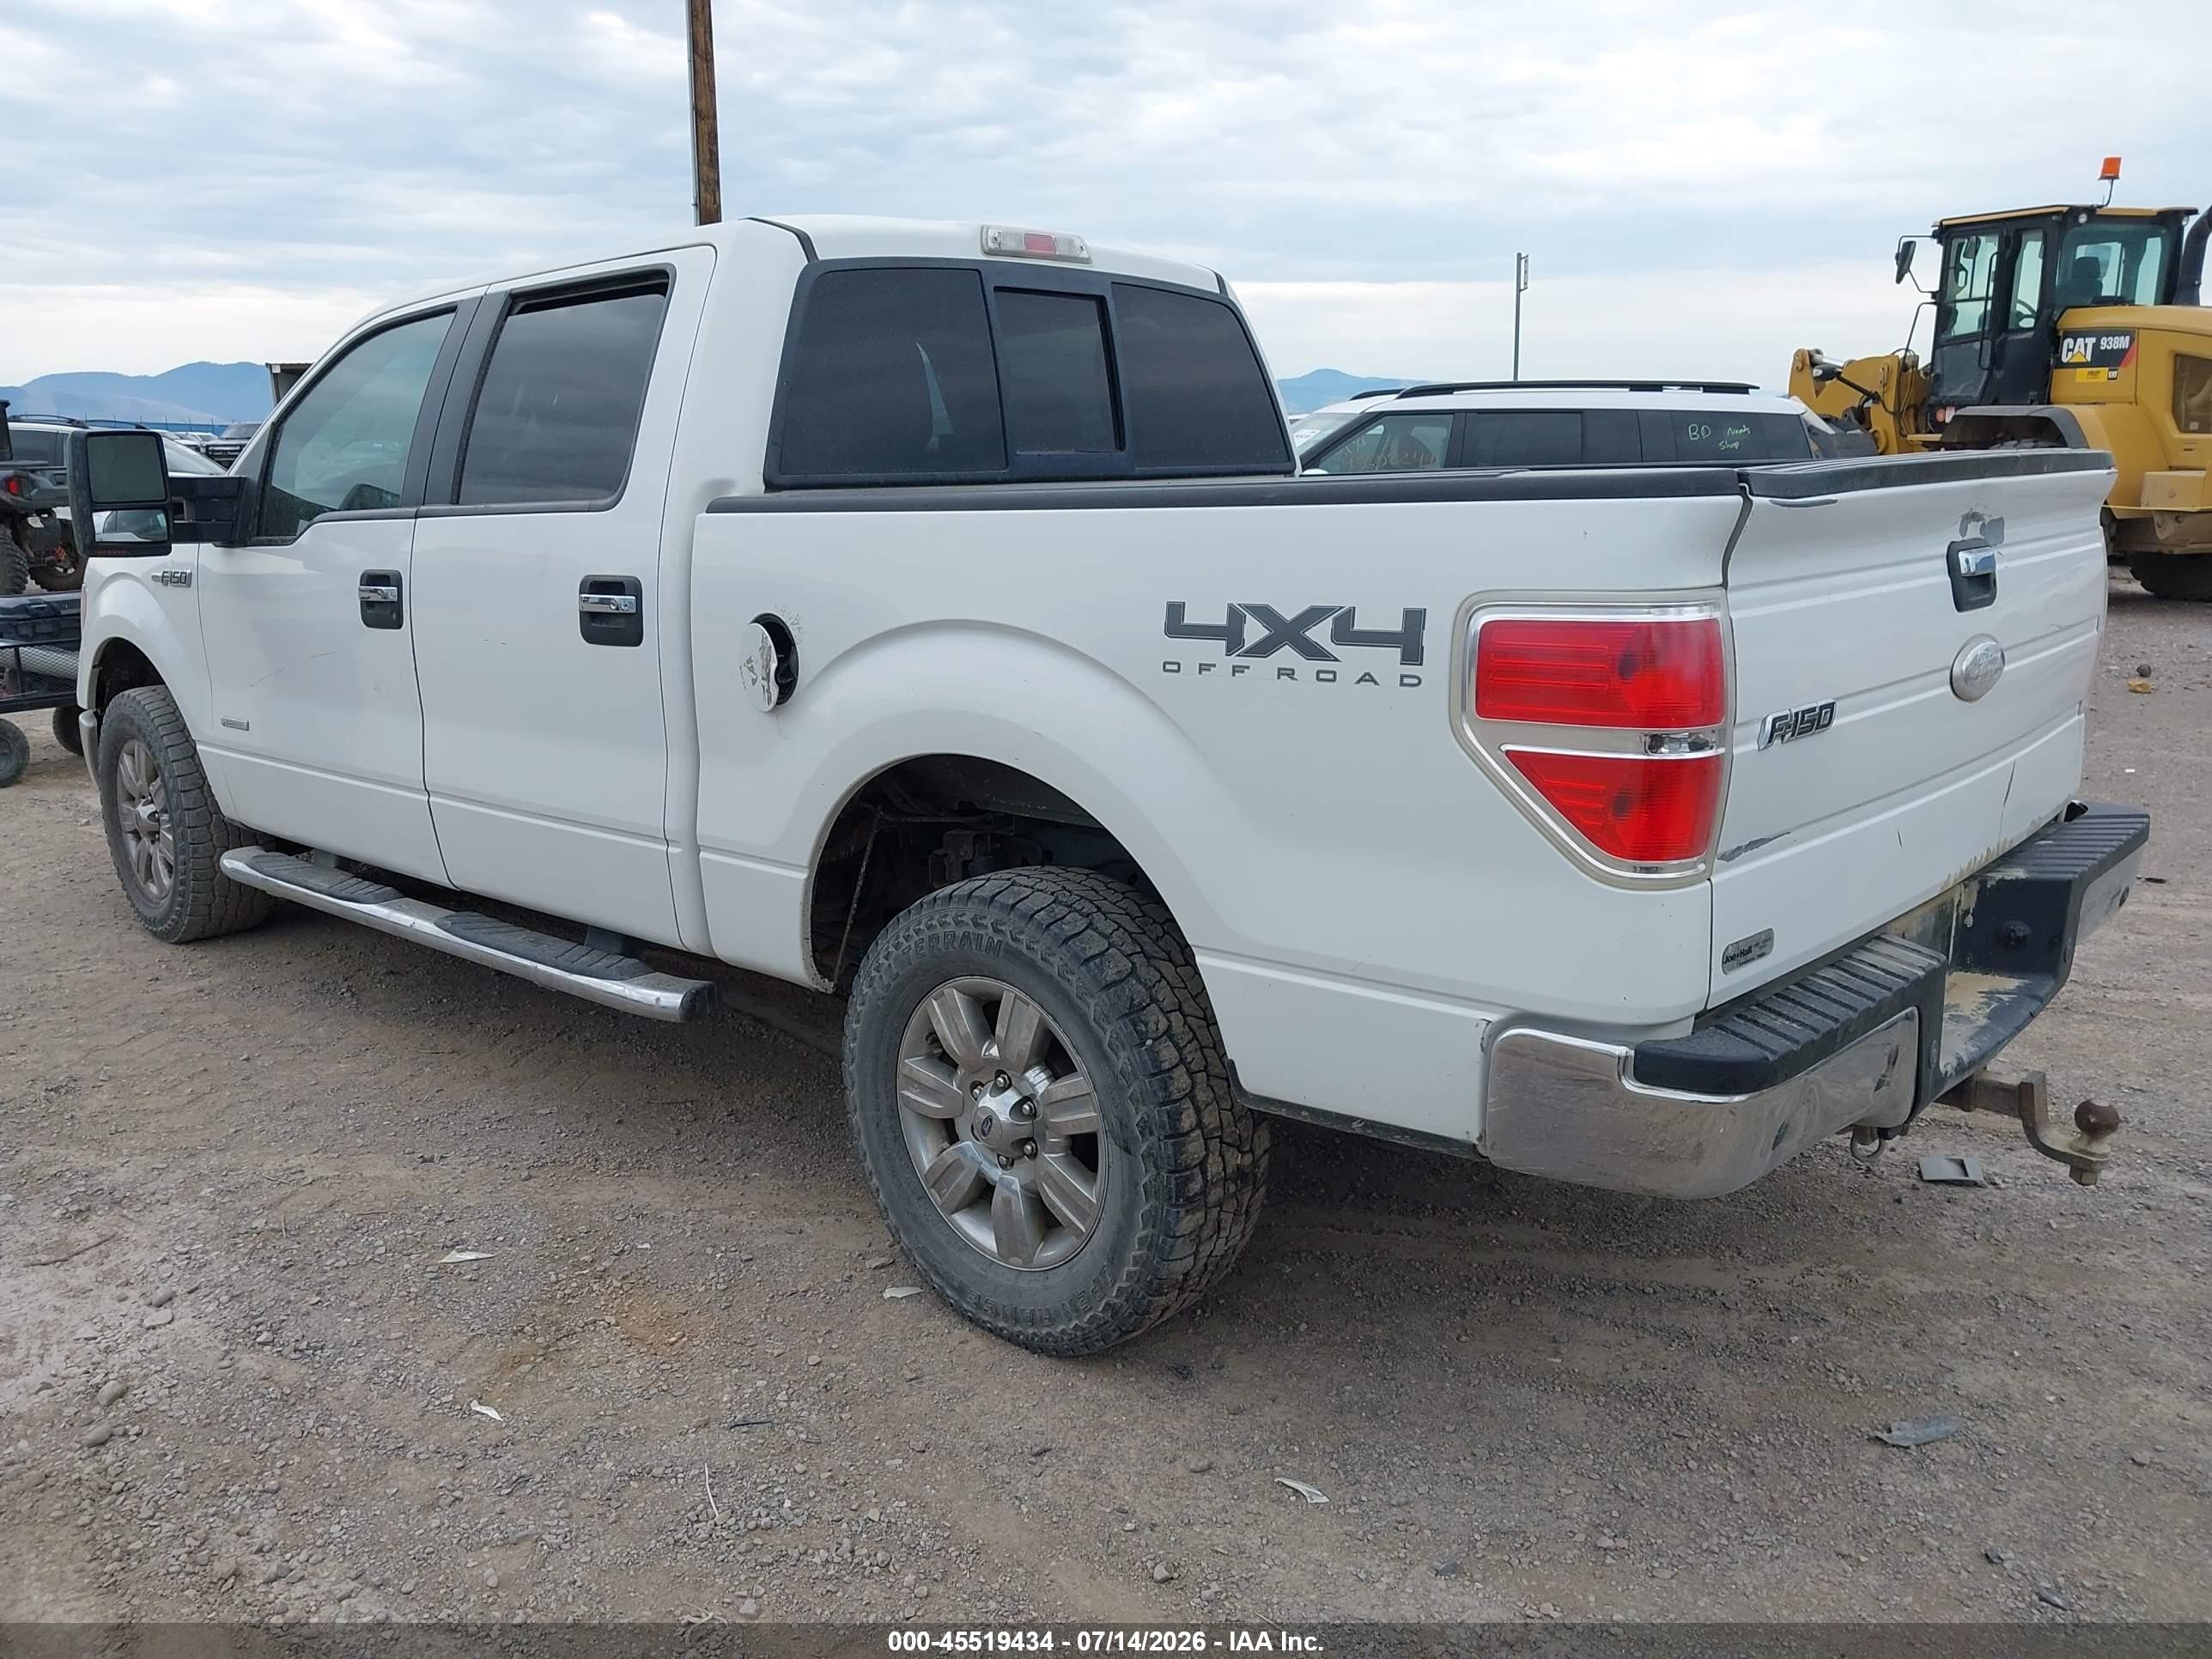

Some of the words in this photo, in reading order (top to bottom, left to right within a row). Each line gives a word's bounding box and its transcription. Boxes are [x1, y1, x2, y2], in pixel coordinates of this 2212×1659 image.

[2061, 337, 2096, 363] CAT
[2100, 336, 2130, 350] 938M
[1163, 660, 1250, 677] OFF
[1277, 667, 1423, 687] ROAD
[902, 930, 1004, 966] TERRAIN
